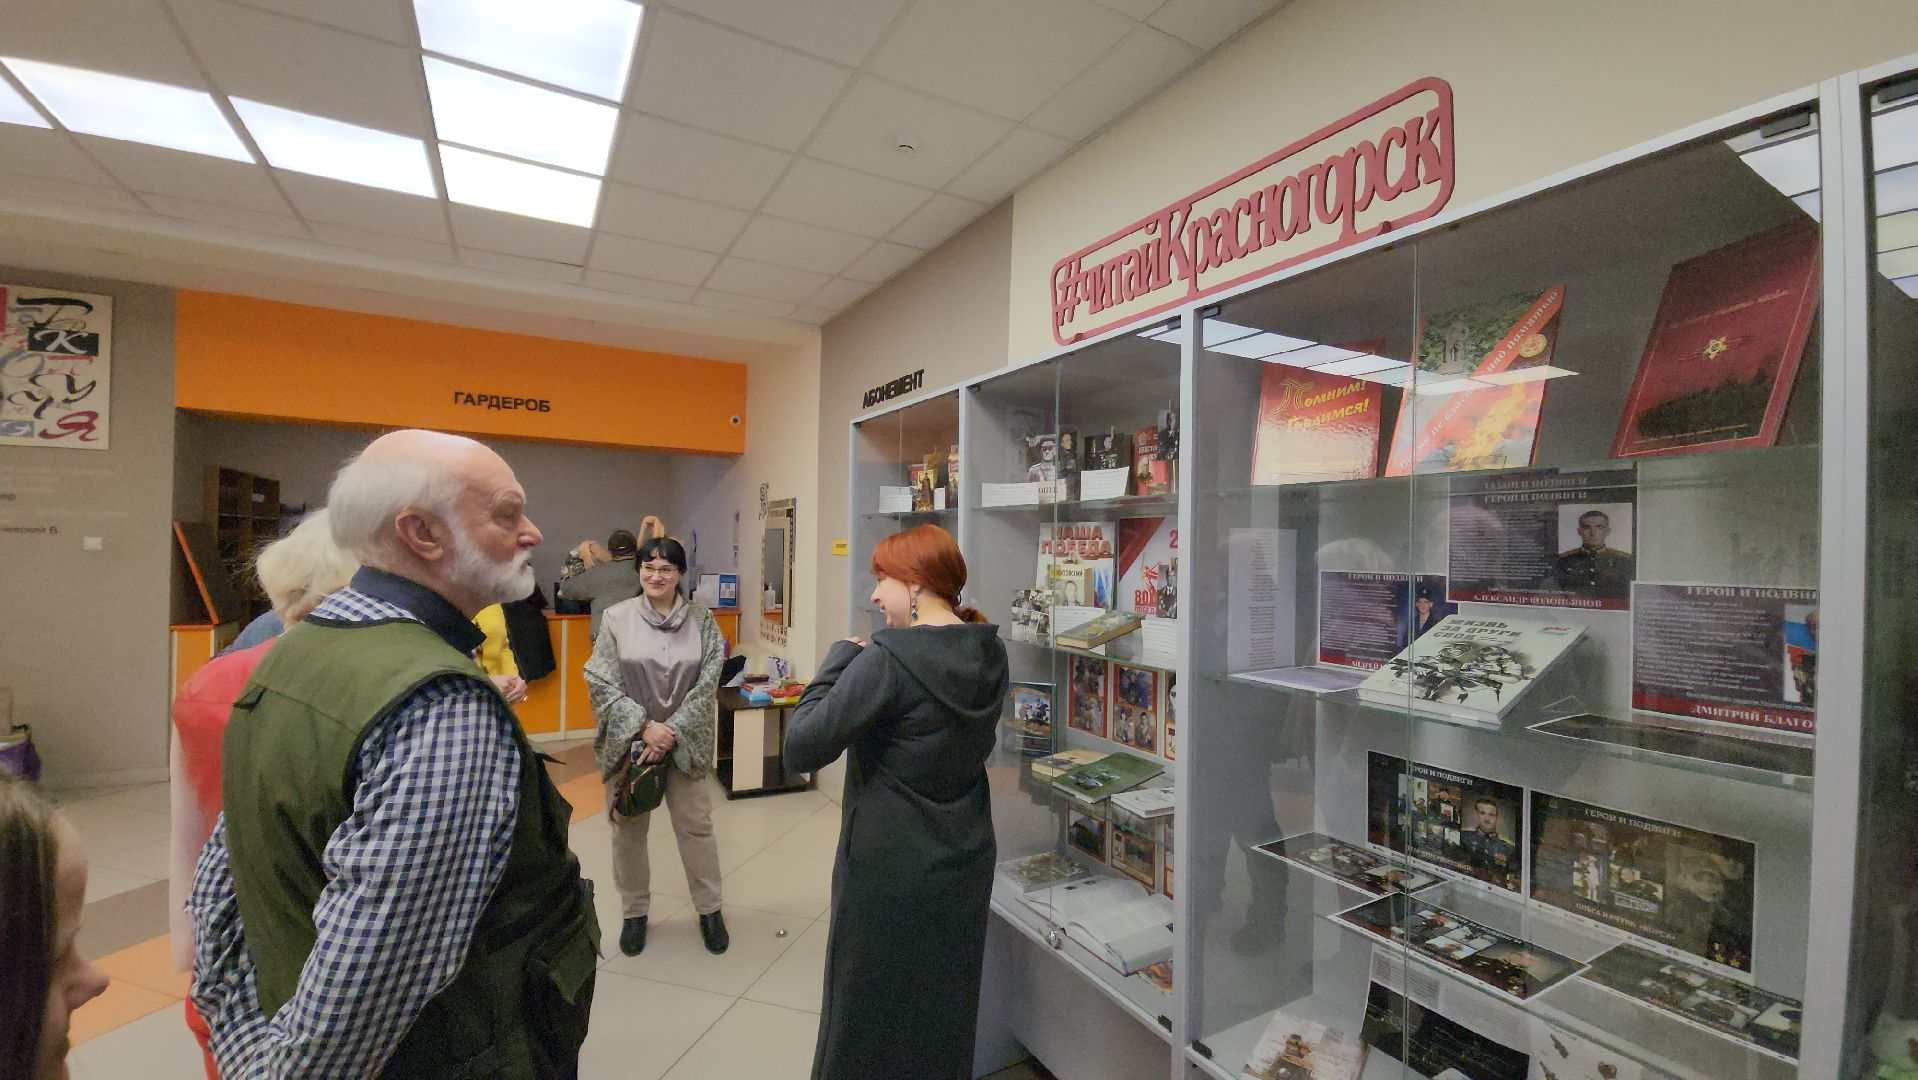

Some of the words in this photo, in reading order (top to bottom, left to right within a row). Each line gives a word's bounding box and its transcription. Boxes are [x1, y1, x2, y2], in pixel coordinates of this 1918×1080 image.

[1055, 106, 1442, 326] #читайКрасногорск
[454, 391, 551, 412] ГАРДЕРОБ
[862, 368, 925, 410] АБОНЕМЕНТ
[1763, 714, 1814, 730] БЛАГО
